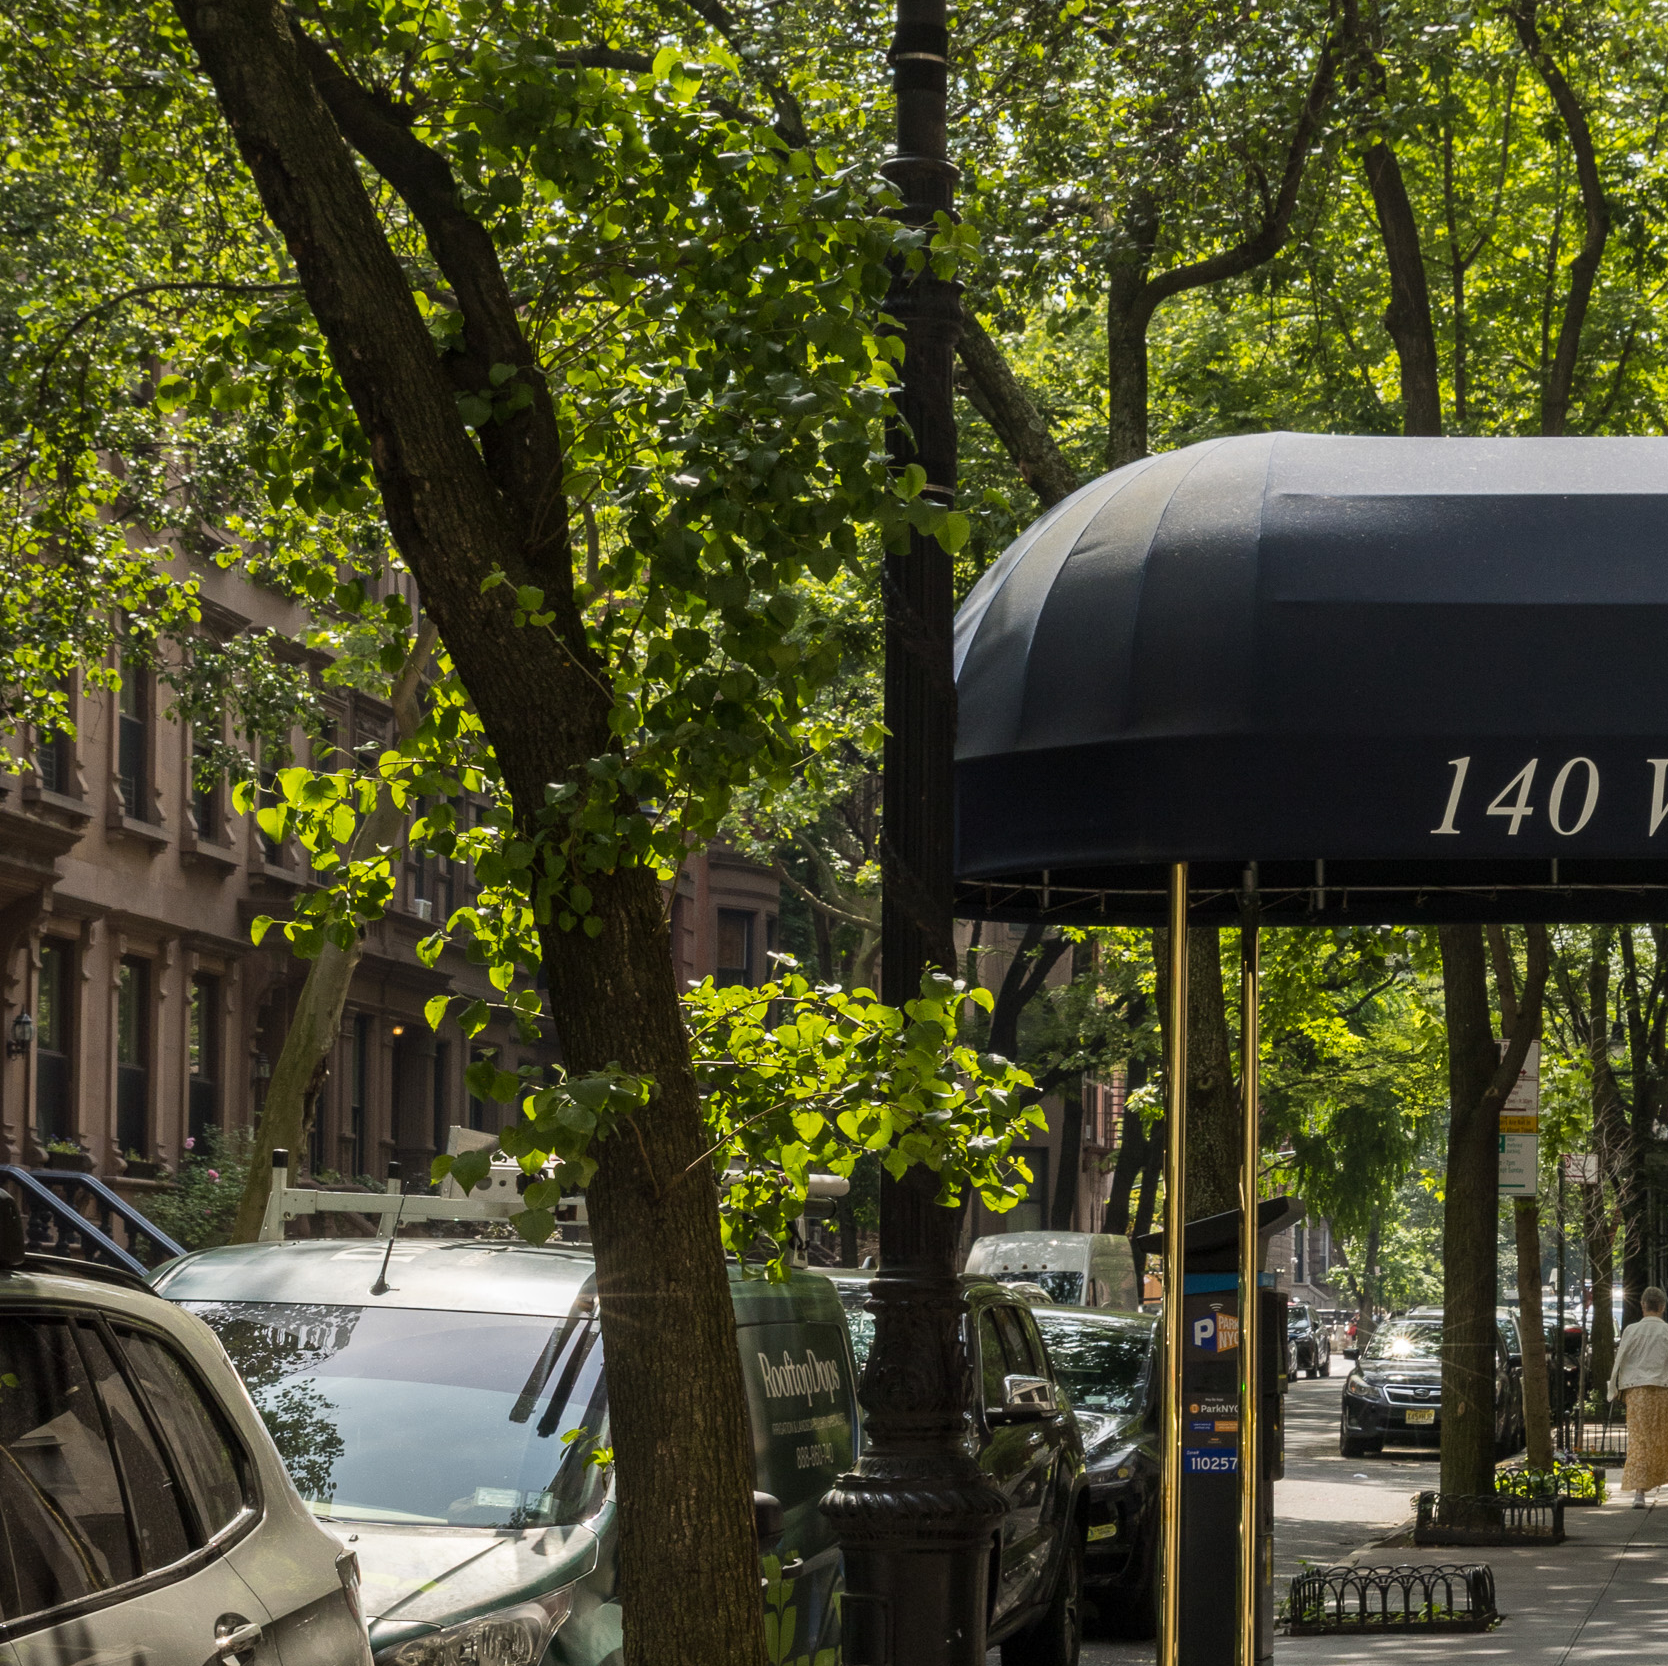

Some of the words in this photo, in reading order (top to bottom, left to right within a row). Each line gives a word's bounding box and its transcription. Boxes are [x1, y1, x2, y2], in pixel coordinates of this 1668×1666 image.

[1431, 756, 1600, 836] 140
[1194, 1318, 1215, 1346] P
[1191, 1457, 1238, 1470] 110257
